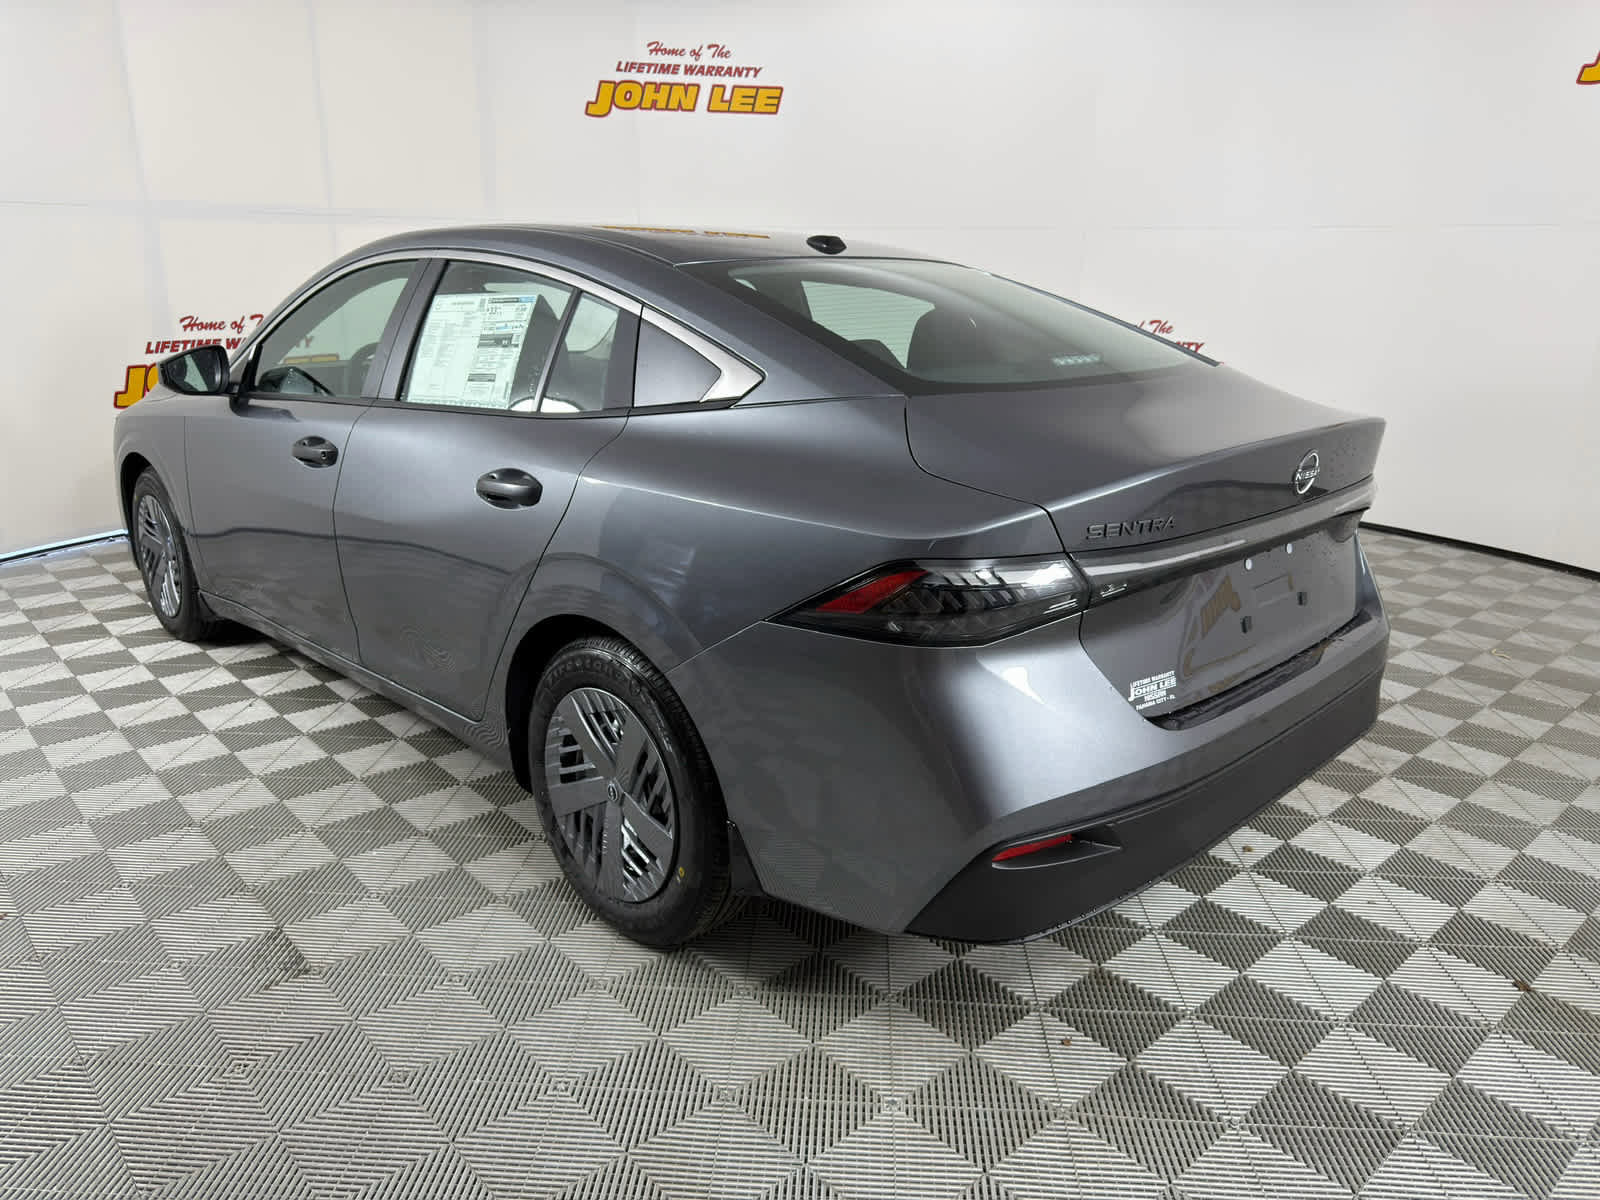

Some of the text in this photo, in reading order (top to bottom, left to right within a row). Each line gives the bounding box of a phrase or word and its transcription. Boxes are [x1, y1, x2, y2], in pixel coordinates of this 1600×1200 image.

[647, 41, 732, 61] Home of The
[616, 60, 763, 78] LIFETIME WARRANTY
[585, 80, 784, 118] JOHN LEE
[179, 315, 226, 332] Home
[230, 316, 245, 334] of
[1149, 319, 1174, 335] The
[1086, 514, 1177, 540] SENTRA
[1128, 678, 1176, 702] JOHN LEE
